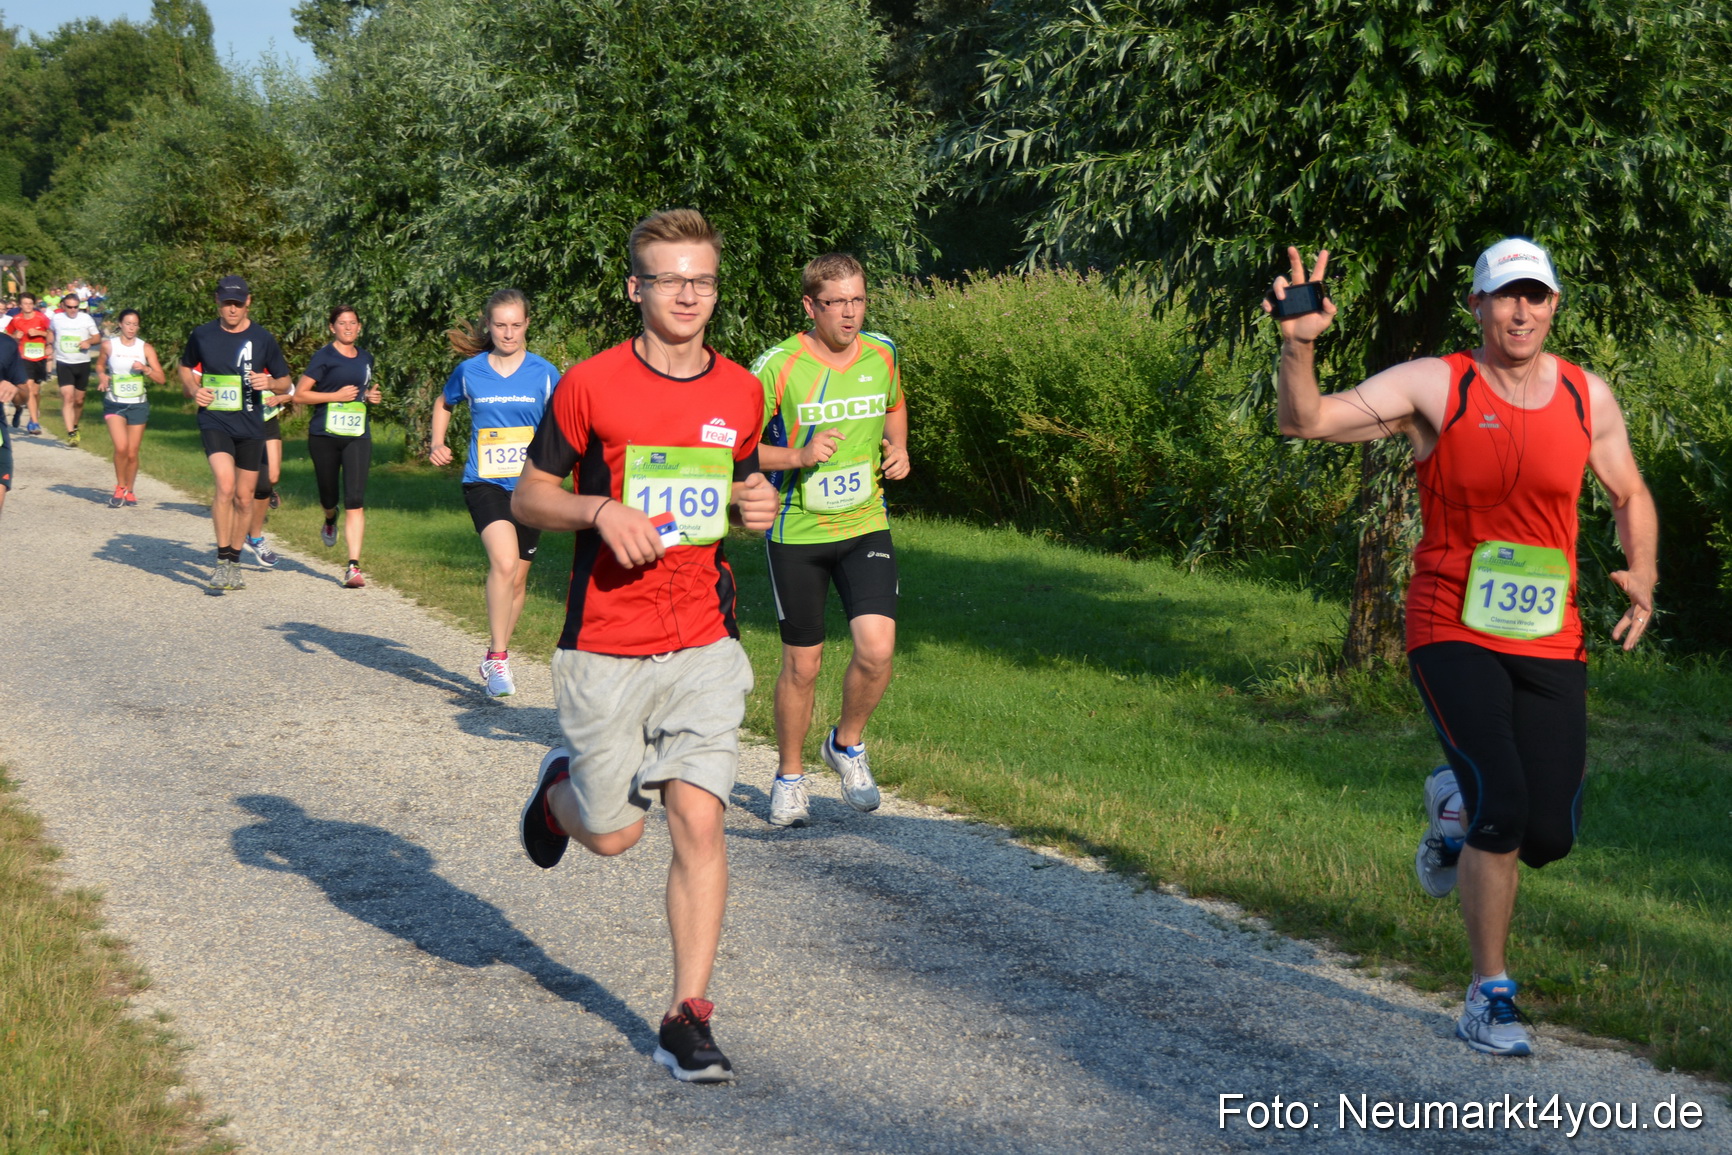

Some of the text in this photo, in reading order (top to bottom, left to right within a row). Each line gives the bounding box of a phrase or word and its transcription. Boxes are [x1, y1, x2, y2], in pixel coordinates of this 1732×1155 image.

[120, 384, 138, 392] 586
[213, 390, 237, 401] 140
[332, 415, 361, 426] 1132
[797, 394, 886, 425] BOCK
[484, 446, 528, 465] 1328
[818, 471, 861, 497] 135
[636, 486, 719, 517] 1169
[1480, 579, 1556, 616] 1393
